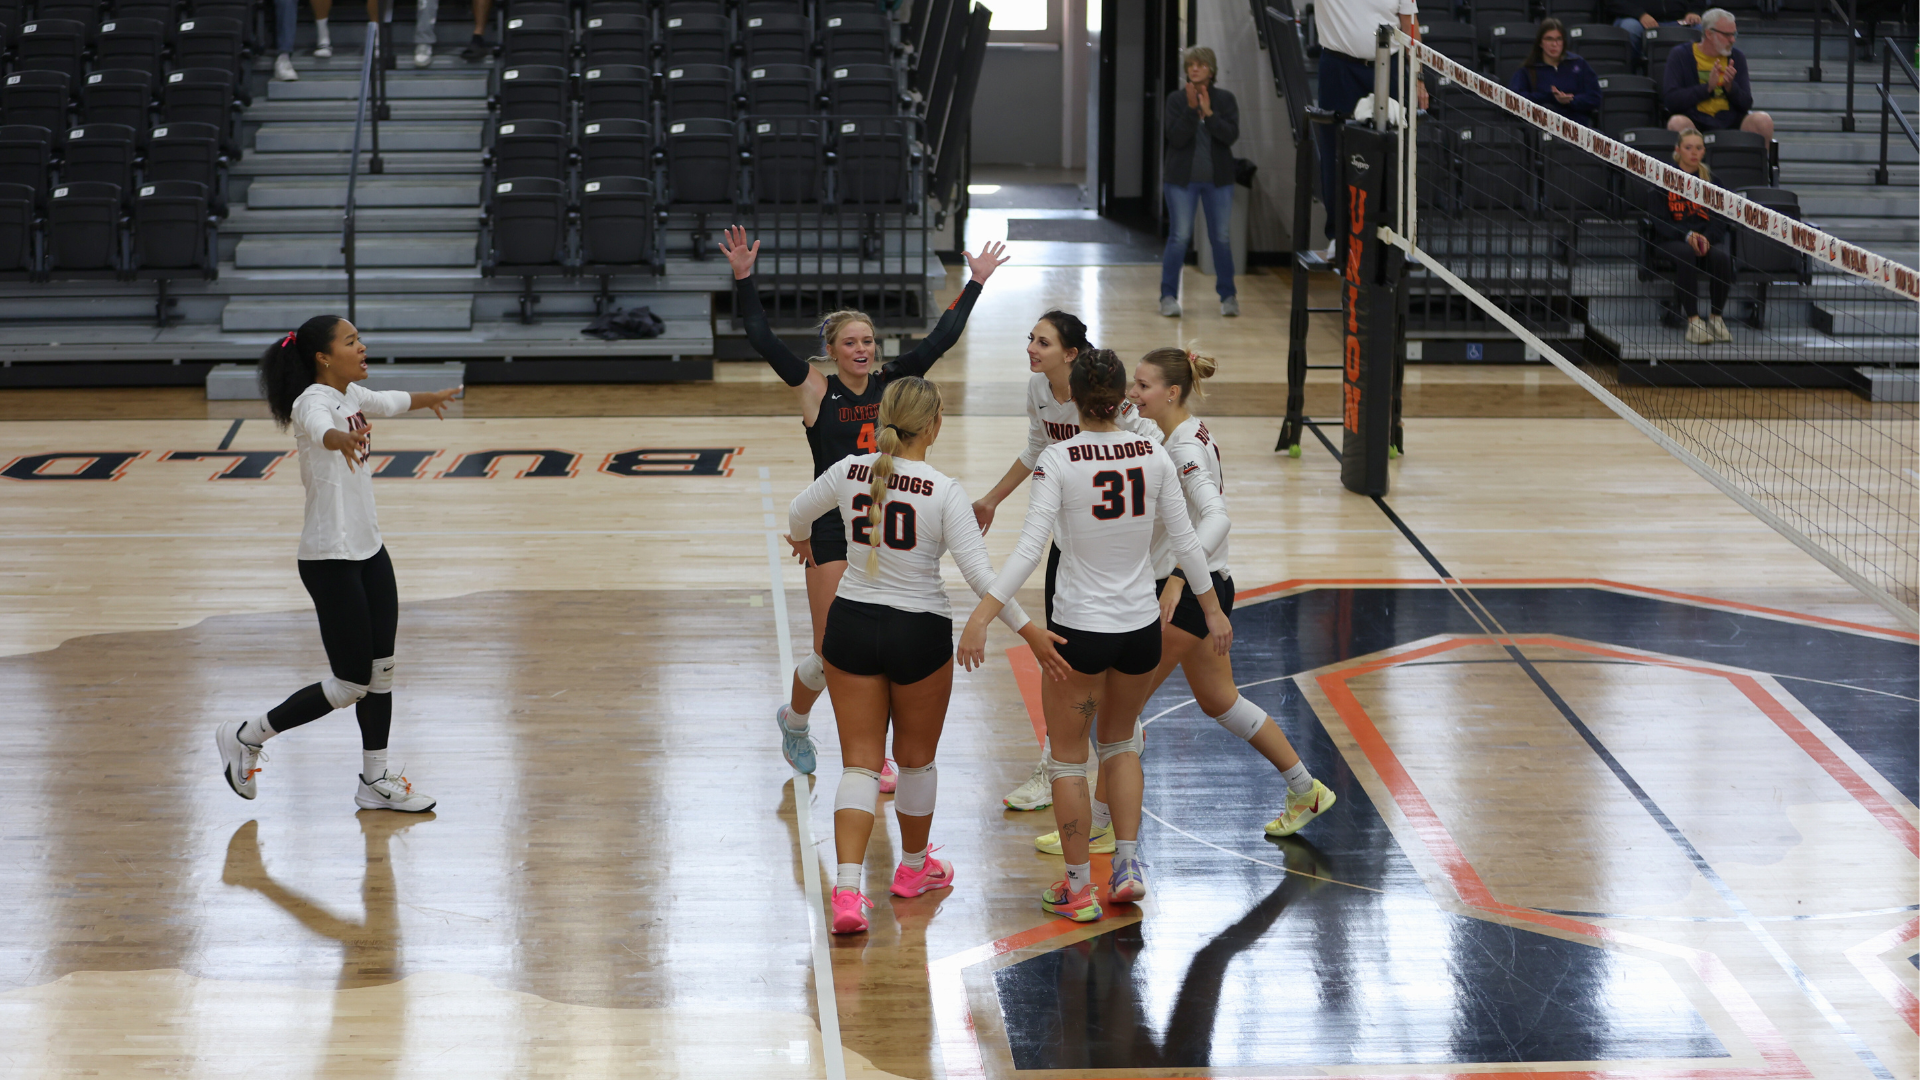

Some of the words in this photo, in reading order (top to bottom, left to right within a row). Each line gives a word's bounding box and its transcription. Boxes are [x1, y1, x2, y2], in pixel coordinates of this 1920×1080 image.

[1343, 184, 1367, 434] UNION
[856, 422, 877, 454] 4
[1066, 440, 1154, 462] BULLDOGS
[846, 463, 935, 497] BUDOGS
[1091, 466, 1146, 521] 31
[851, 492, 918, 552] 20
